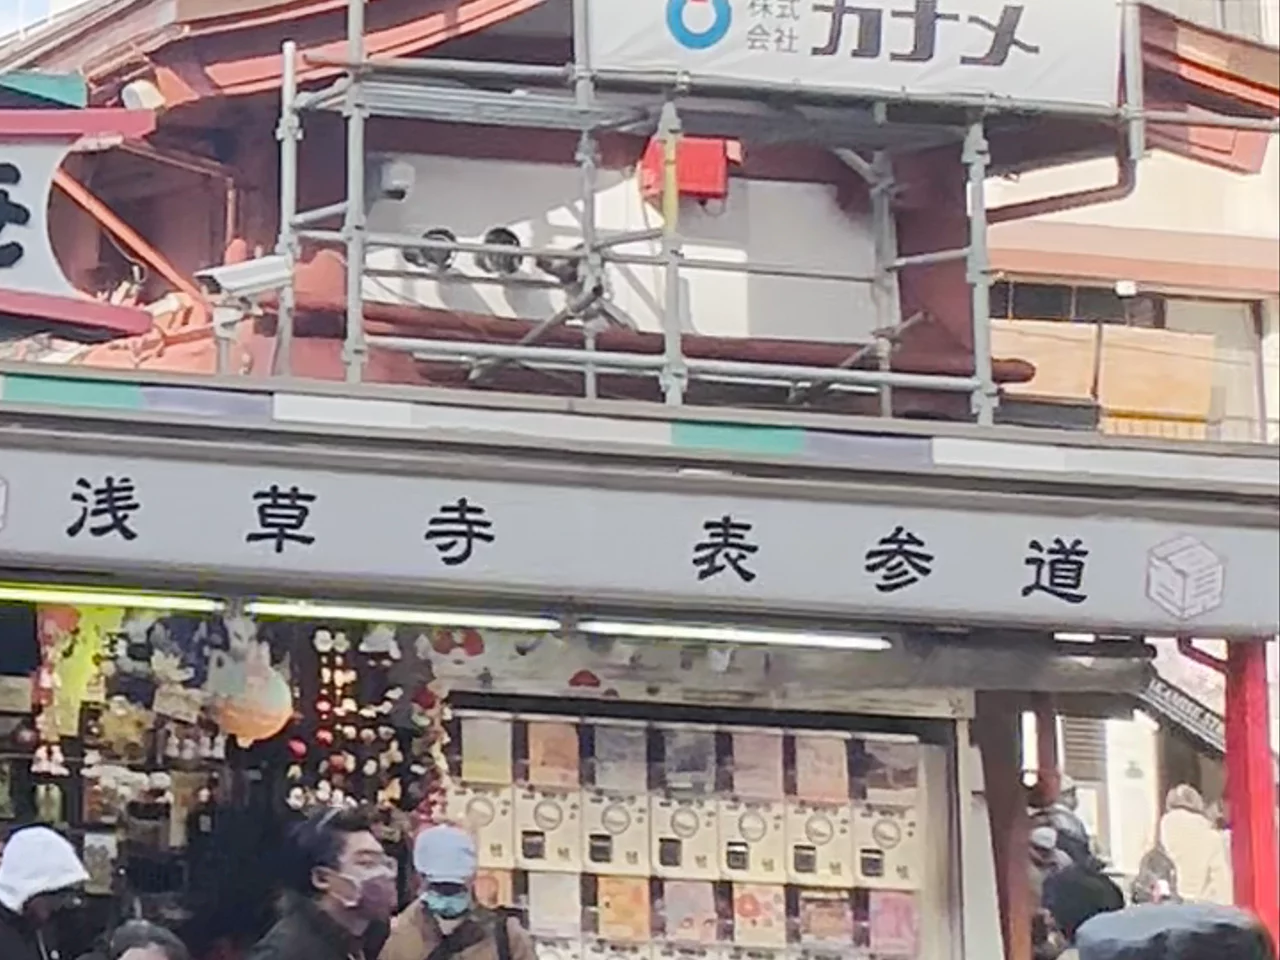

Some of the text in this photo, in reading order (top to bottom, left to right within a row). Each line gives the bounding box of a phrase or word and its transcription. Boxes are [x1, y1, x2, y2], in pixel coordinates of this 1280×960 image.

[746, 23, 799, 54] 会社
[810, 0, 1041, 67] カナメ
